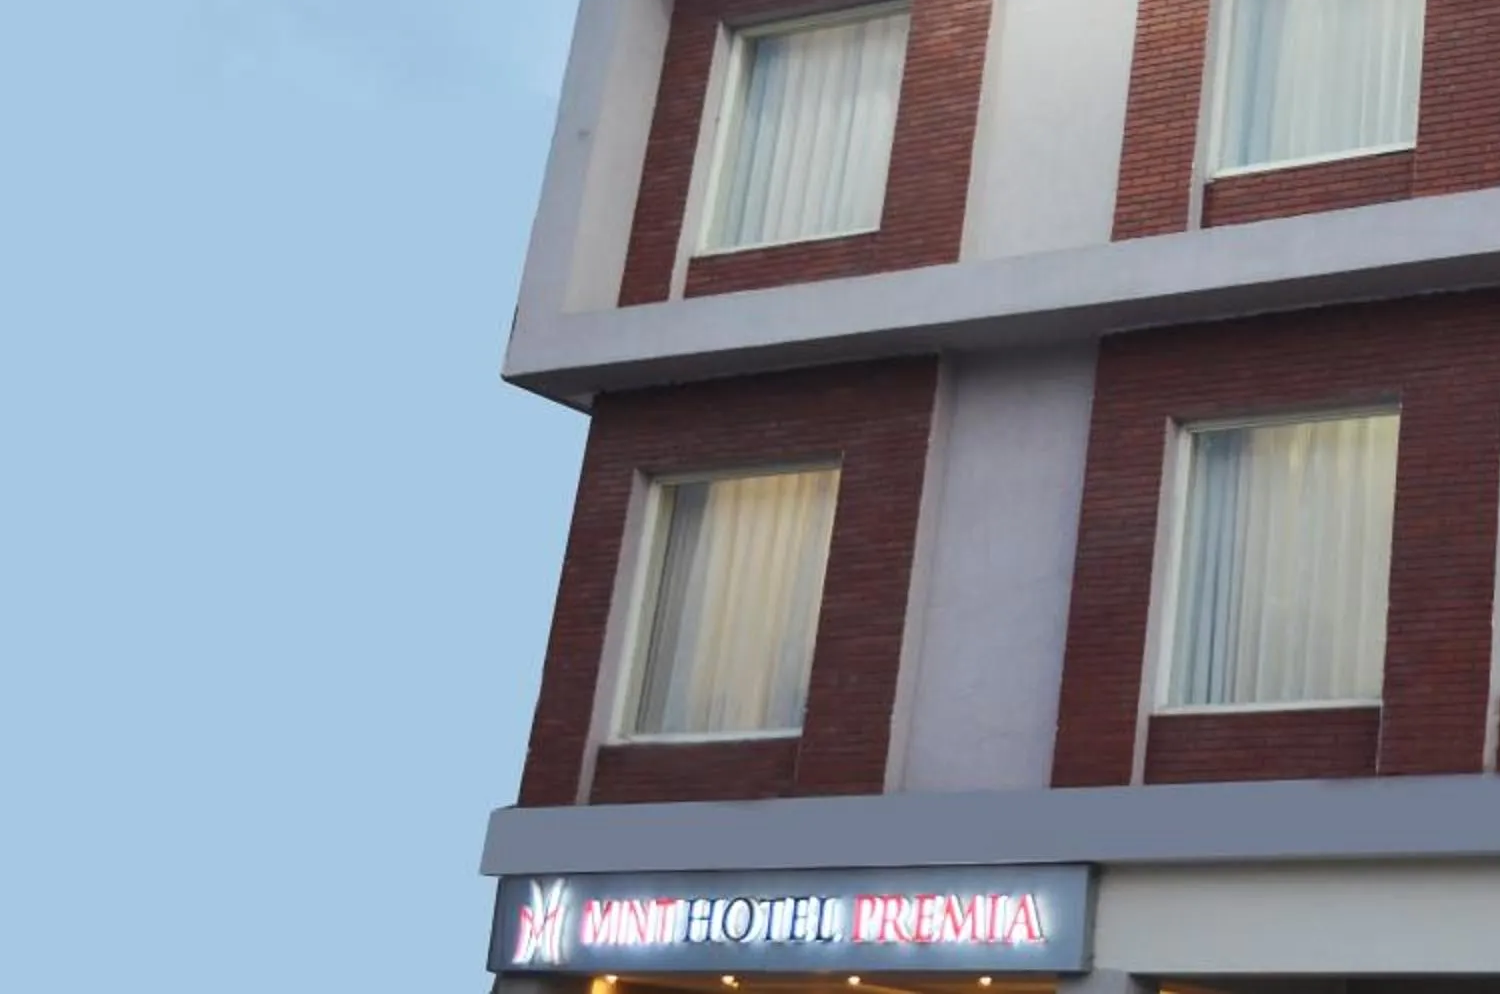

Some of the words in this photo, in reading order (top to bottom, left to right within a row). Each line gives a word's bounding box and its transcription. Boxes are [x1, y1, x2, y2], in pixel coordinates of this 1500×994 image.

[580, 898, 680, 945] MINT
[680, 896, 843, 943] HOTEL
[852, 892, 1048, 944] PREMIA
